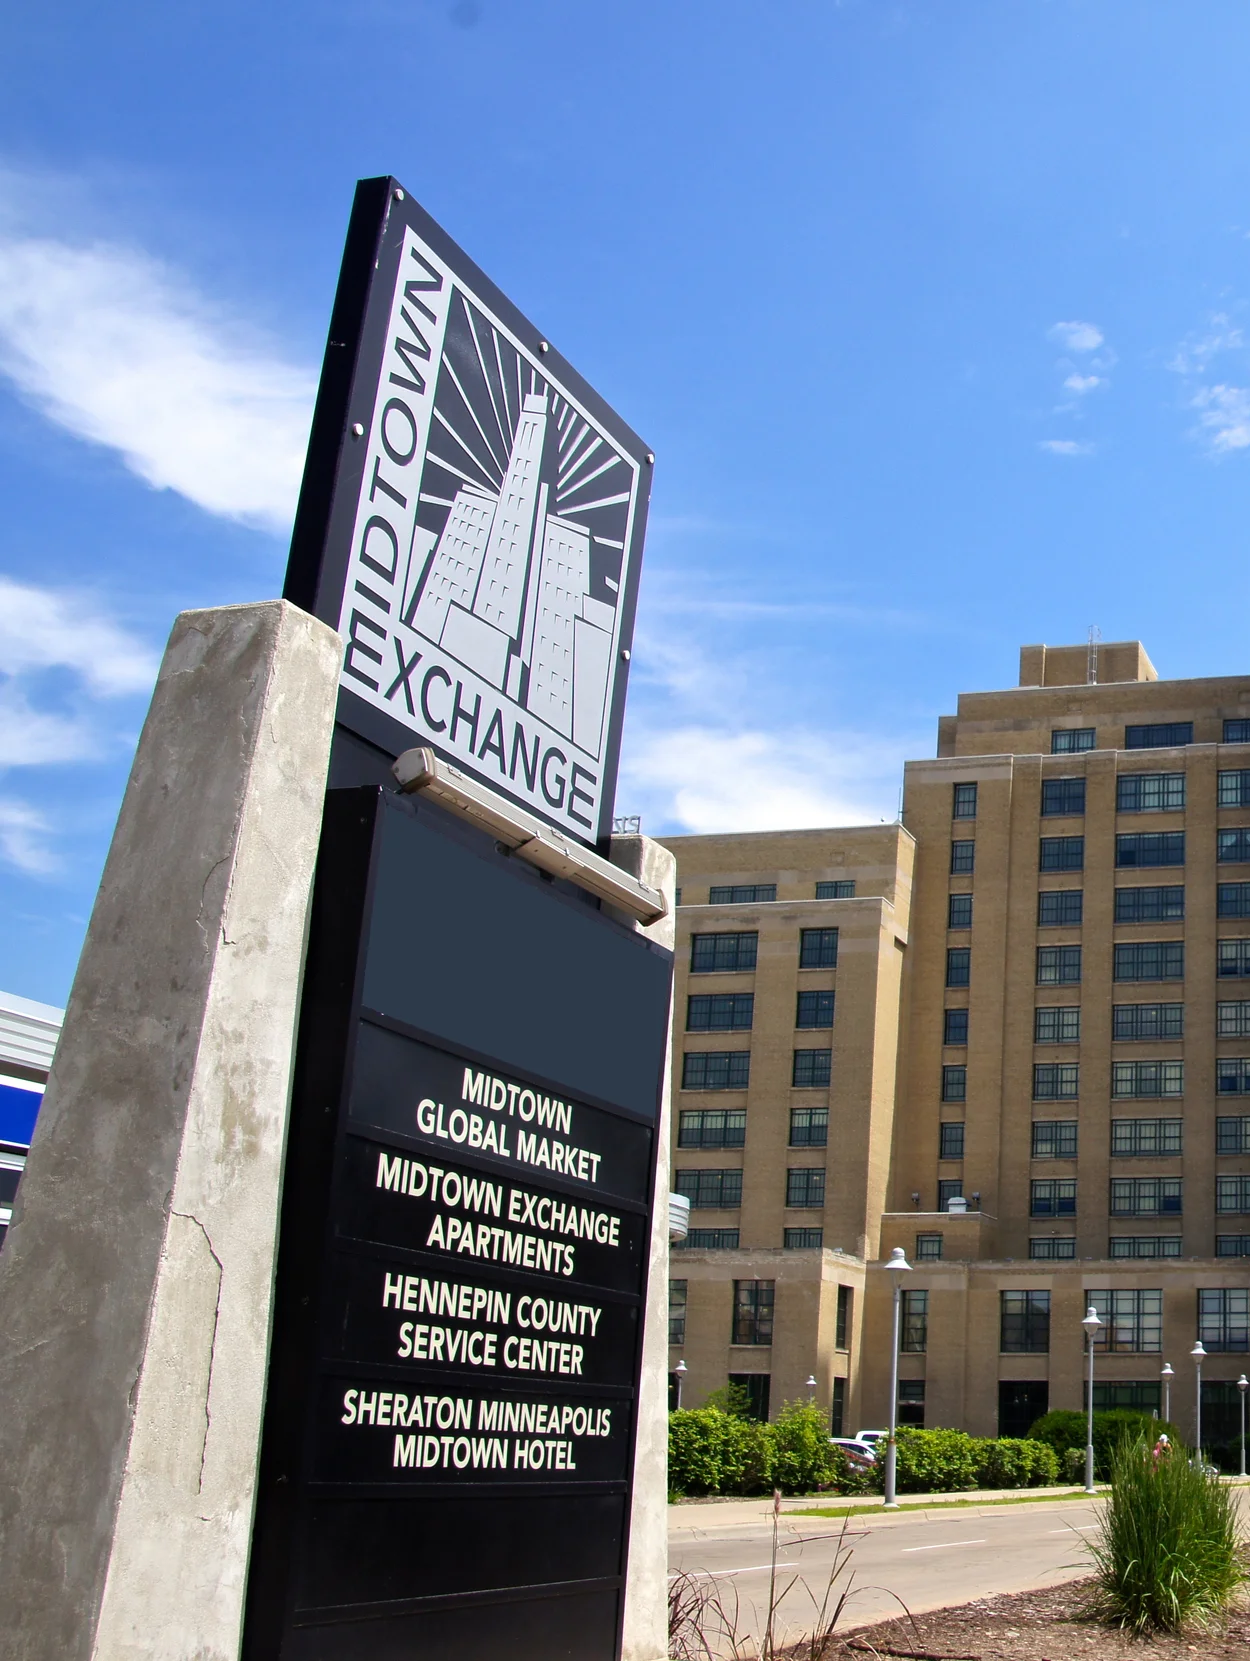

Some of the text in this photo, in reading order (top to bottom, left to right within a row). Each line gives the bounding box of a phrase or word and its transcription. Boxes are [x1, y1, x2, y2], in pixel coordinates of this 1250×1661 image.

[462, 1067, 573, 1135] MIDTOWN
[416, 1099, 601, 1183] GLOBAL MARKET
[376, 1153, 621, 1247] MIDTOWN EXCHANGE
[426, 1214, 575, 1276] APARTMENTS
[382, 1272, 602, 1337] HENNEPIN COUNTY
[397, 1322, 584, 1375] SERVICE CENTER
[341, 1389, 611, 1438] SHERATON MINNEAPOLIS
[393, 1434, 576, 1470] MIDTOWN HOTEL
